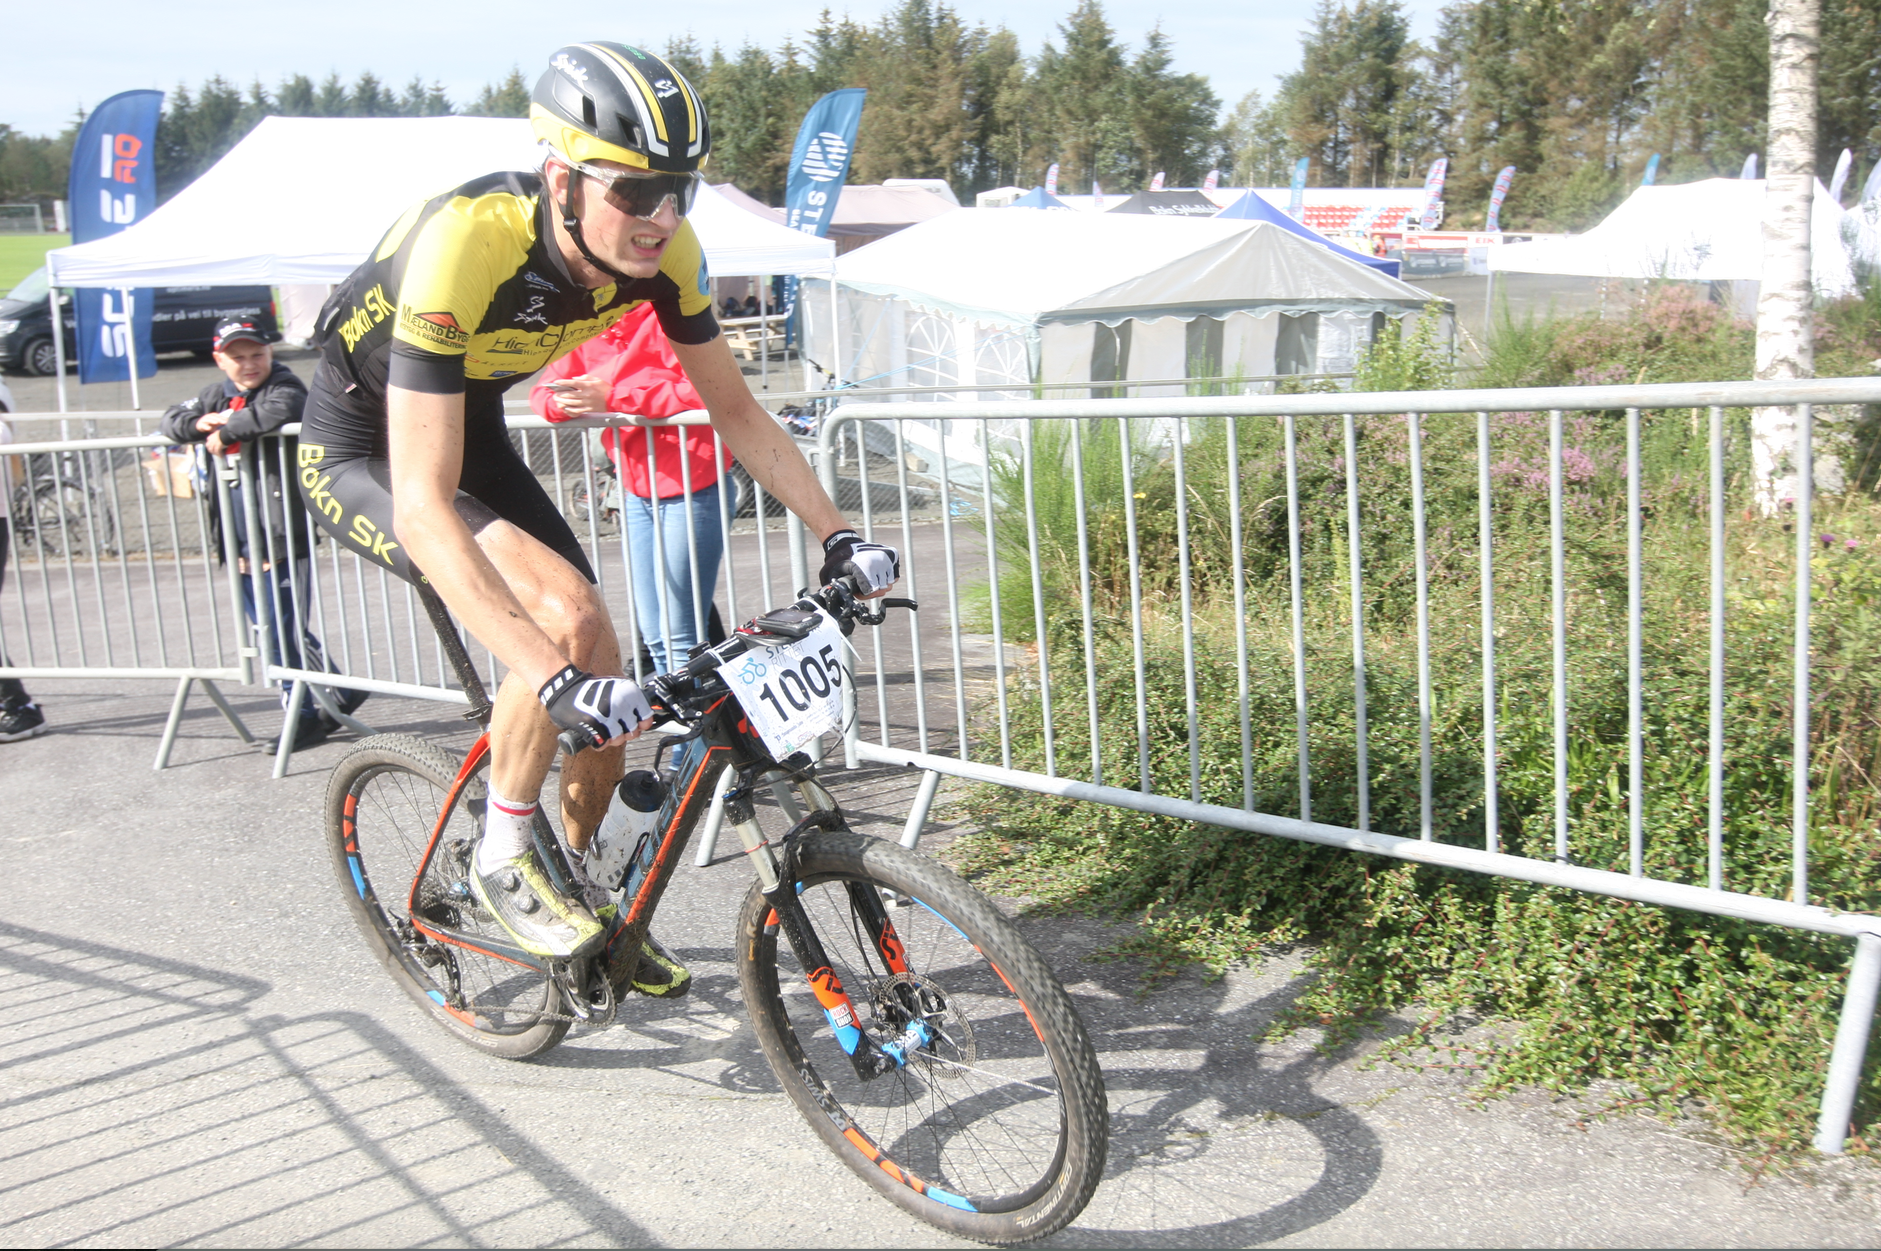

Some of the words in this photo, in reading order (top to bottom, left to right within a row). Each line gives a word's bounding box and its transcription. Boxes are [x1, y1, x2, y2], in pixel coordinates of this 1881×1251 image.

[337, 306, 375, 354] Bokn
[364, 283, 397, 324] SK
[297, 443, 344, 526] Bokn
[348, 514, 399, 567] SK
[759, 644, 842, 723] 1005
